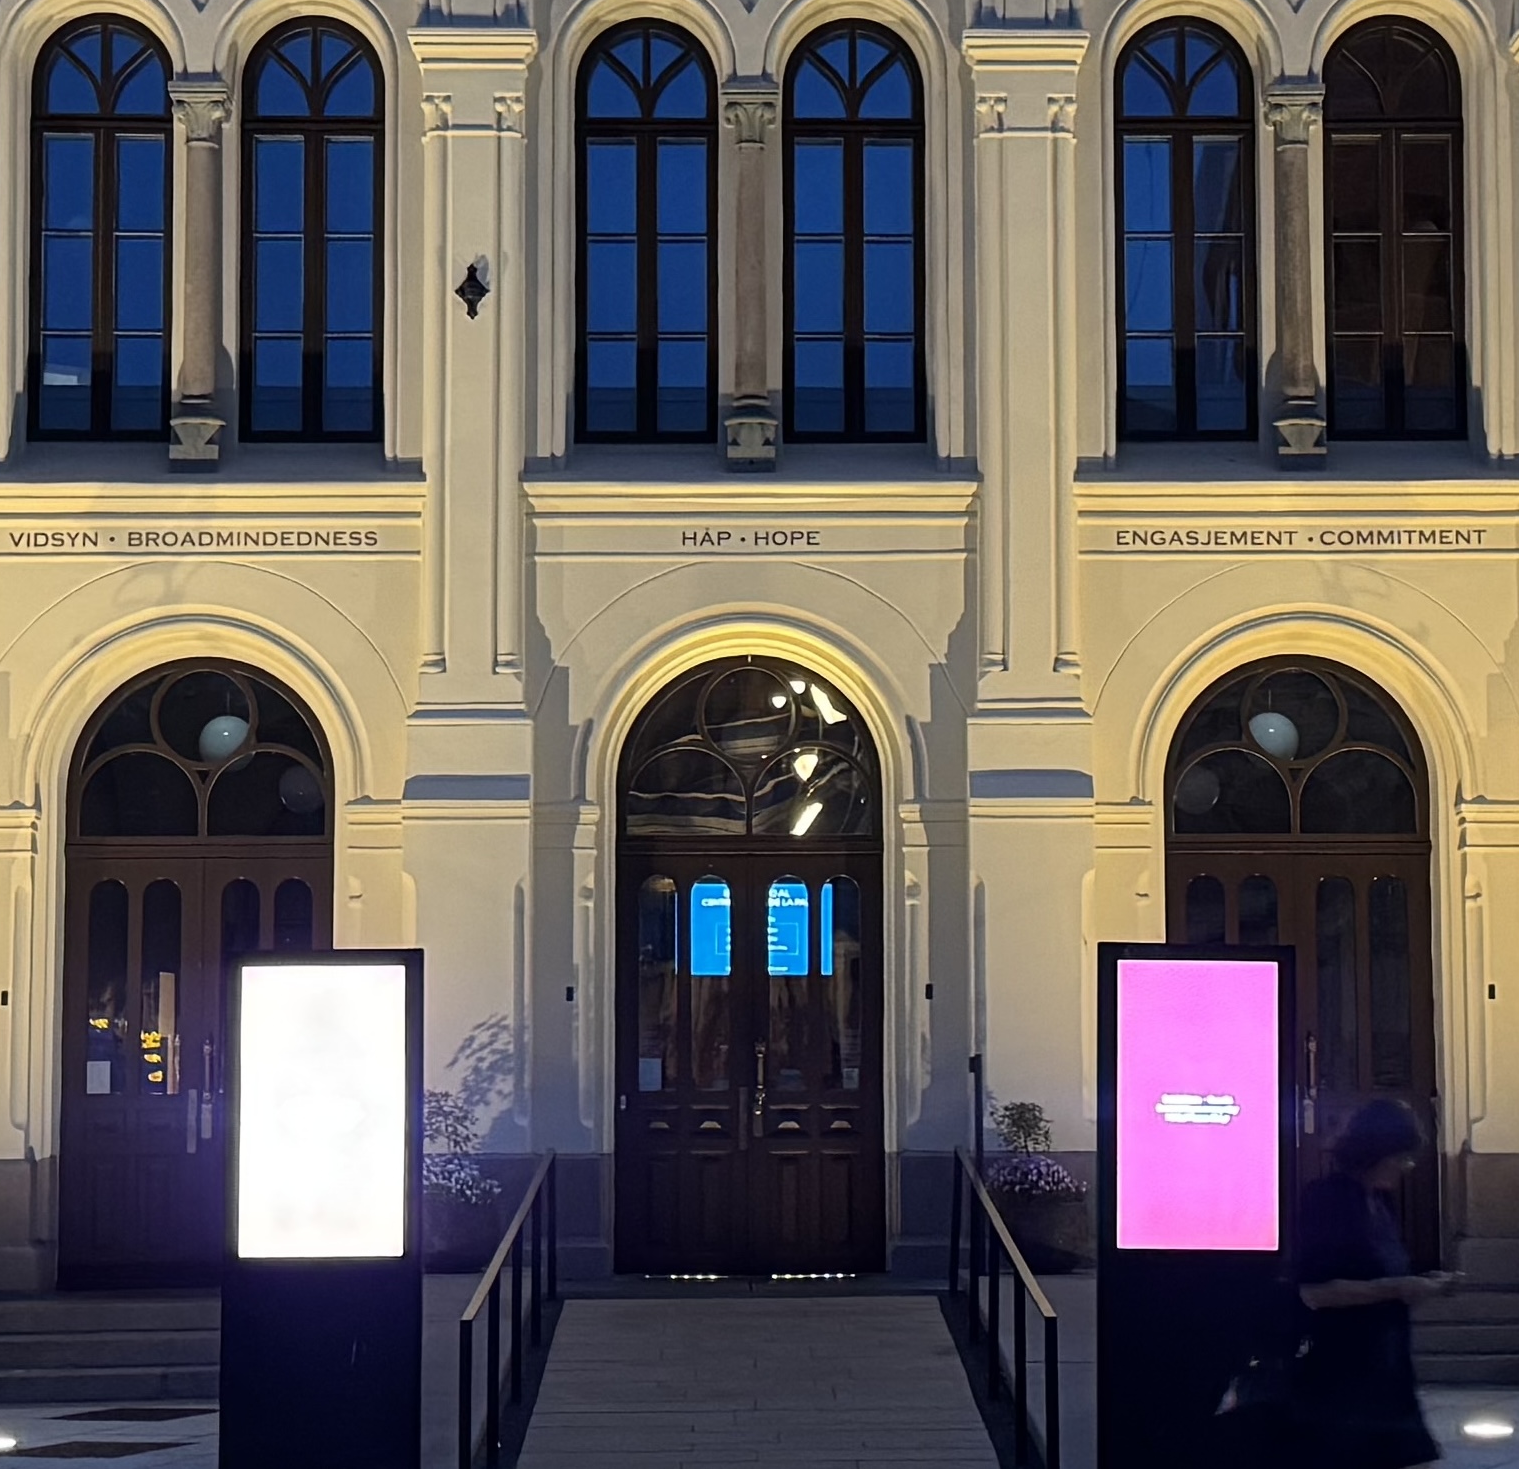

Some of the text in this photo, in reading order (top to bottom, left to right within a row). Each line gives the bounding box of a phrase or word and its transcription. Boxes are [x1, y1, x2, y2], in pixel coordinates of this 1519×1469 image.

[9, 530, 378, 548] VIDSYN BROADMINDEDNESS
[681, 527, 821, 547] HÅP HOPE
[1116, 529, 1487, 546] ENGASJEMENT COMMITMENT
